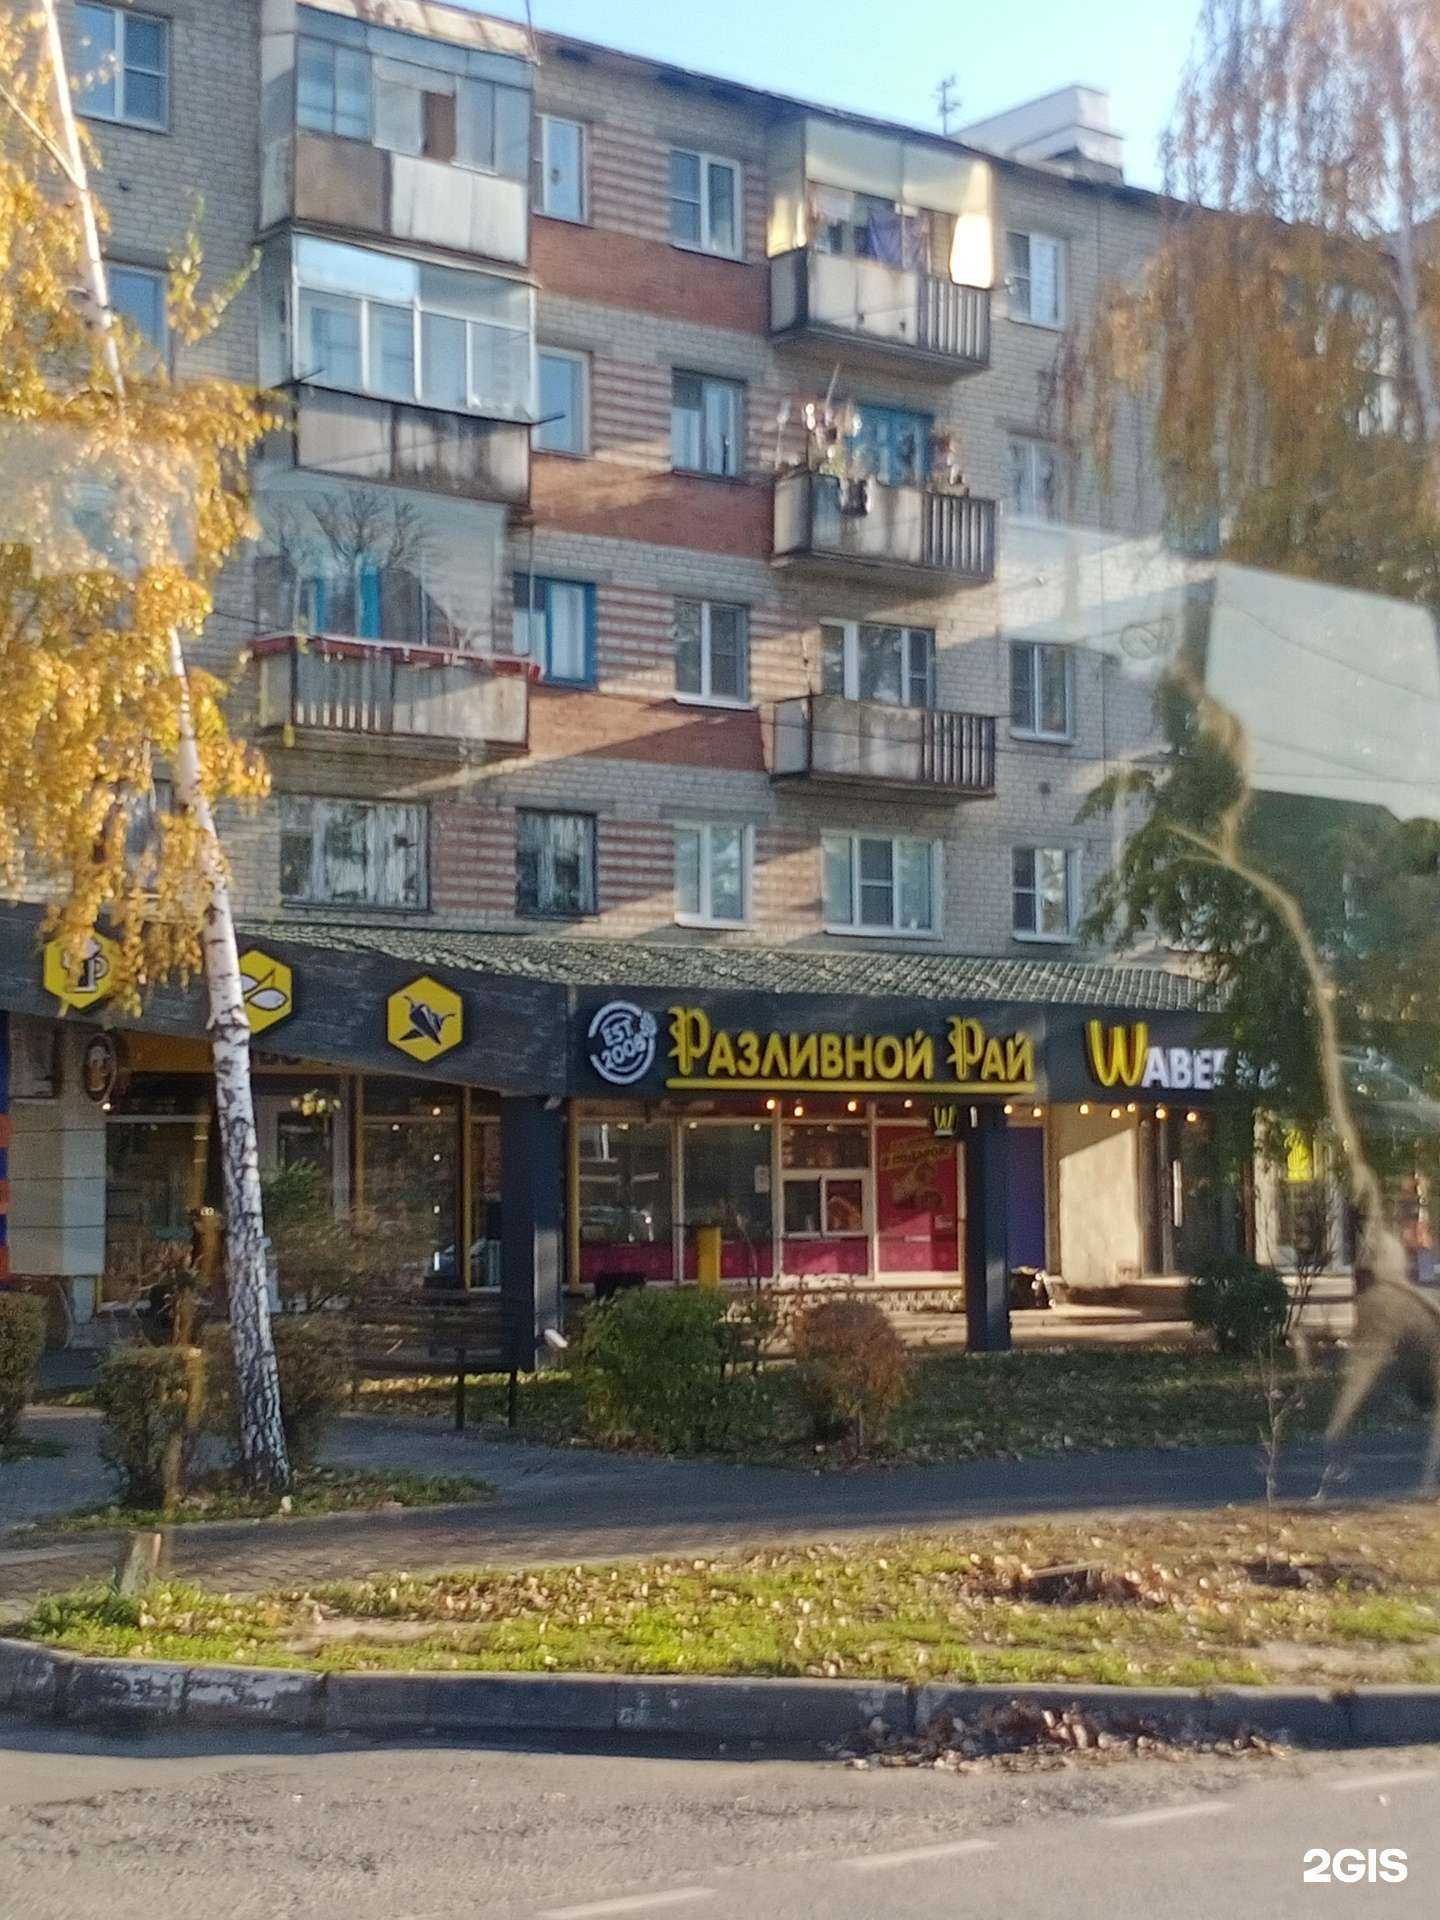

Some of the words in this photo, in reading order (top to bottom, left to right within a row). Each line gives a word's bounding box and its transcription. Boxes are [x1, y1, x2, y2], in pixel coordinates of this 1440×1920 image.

[601, 1019, 634, 1047] EST
[668, 1007, 934, 1080] РАЗЛИВНОЙ
[946, 1016, 1034, 1081] РАЙ
